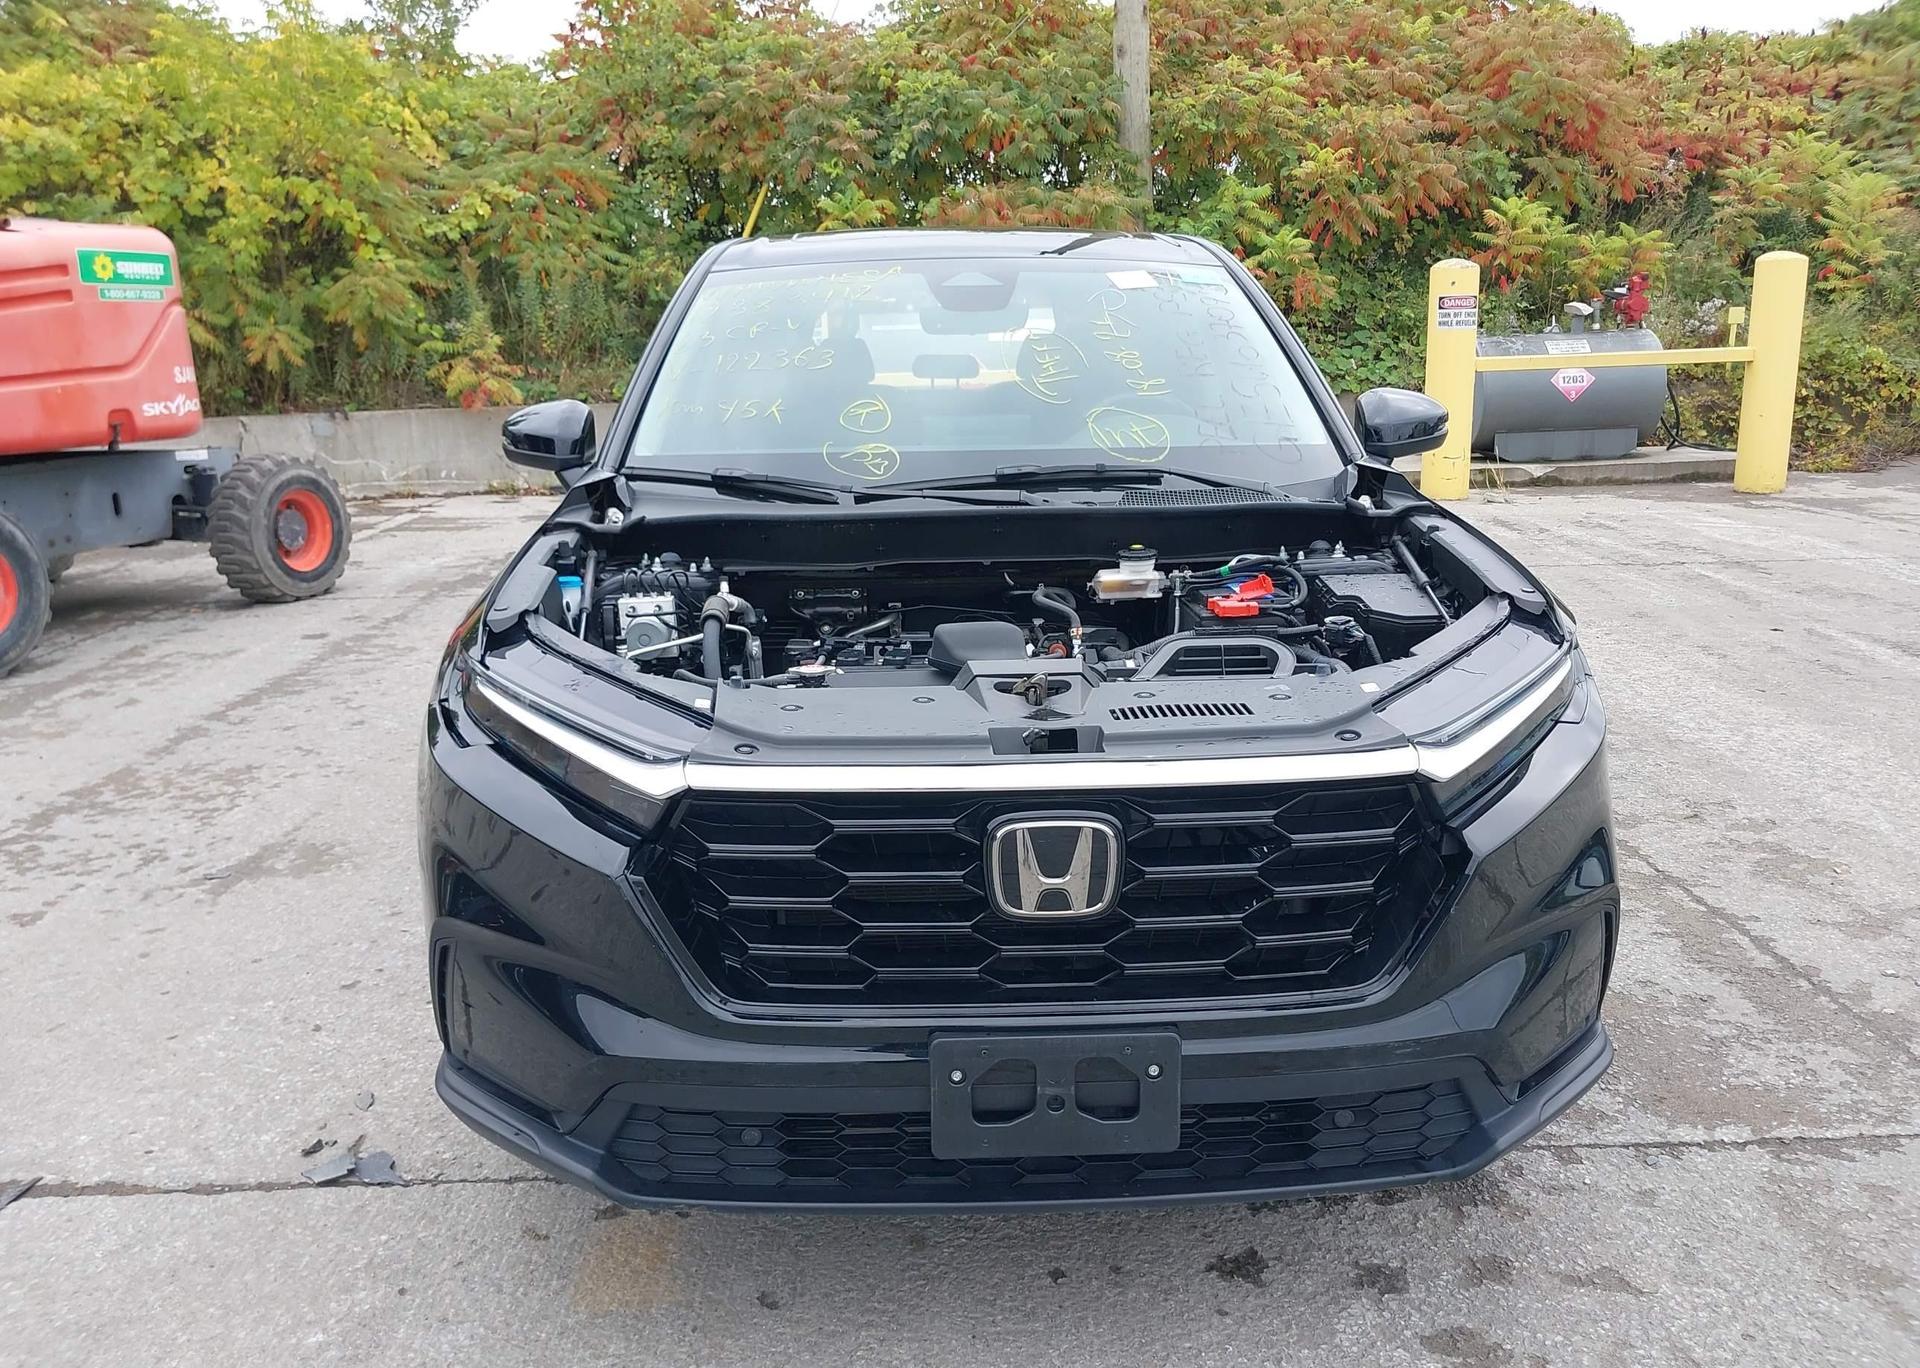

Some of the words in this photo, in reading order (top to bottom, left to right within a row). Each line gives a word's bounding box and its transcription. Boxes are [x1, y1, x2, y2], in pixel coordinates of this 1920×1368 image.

[1444, 298, 1475, 307] DANGER
[1439, 311, 1451, 319] TURN
[1453, 311, 1462, 319] OFF
[1562, 375, 1585, 385] 1203
[1569, 390, 1576, 398] 3
